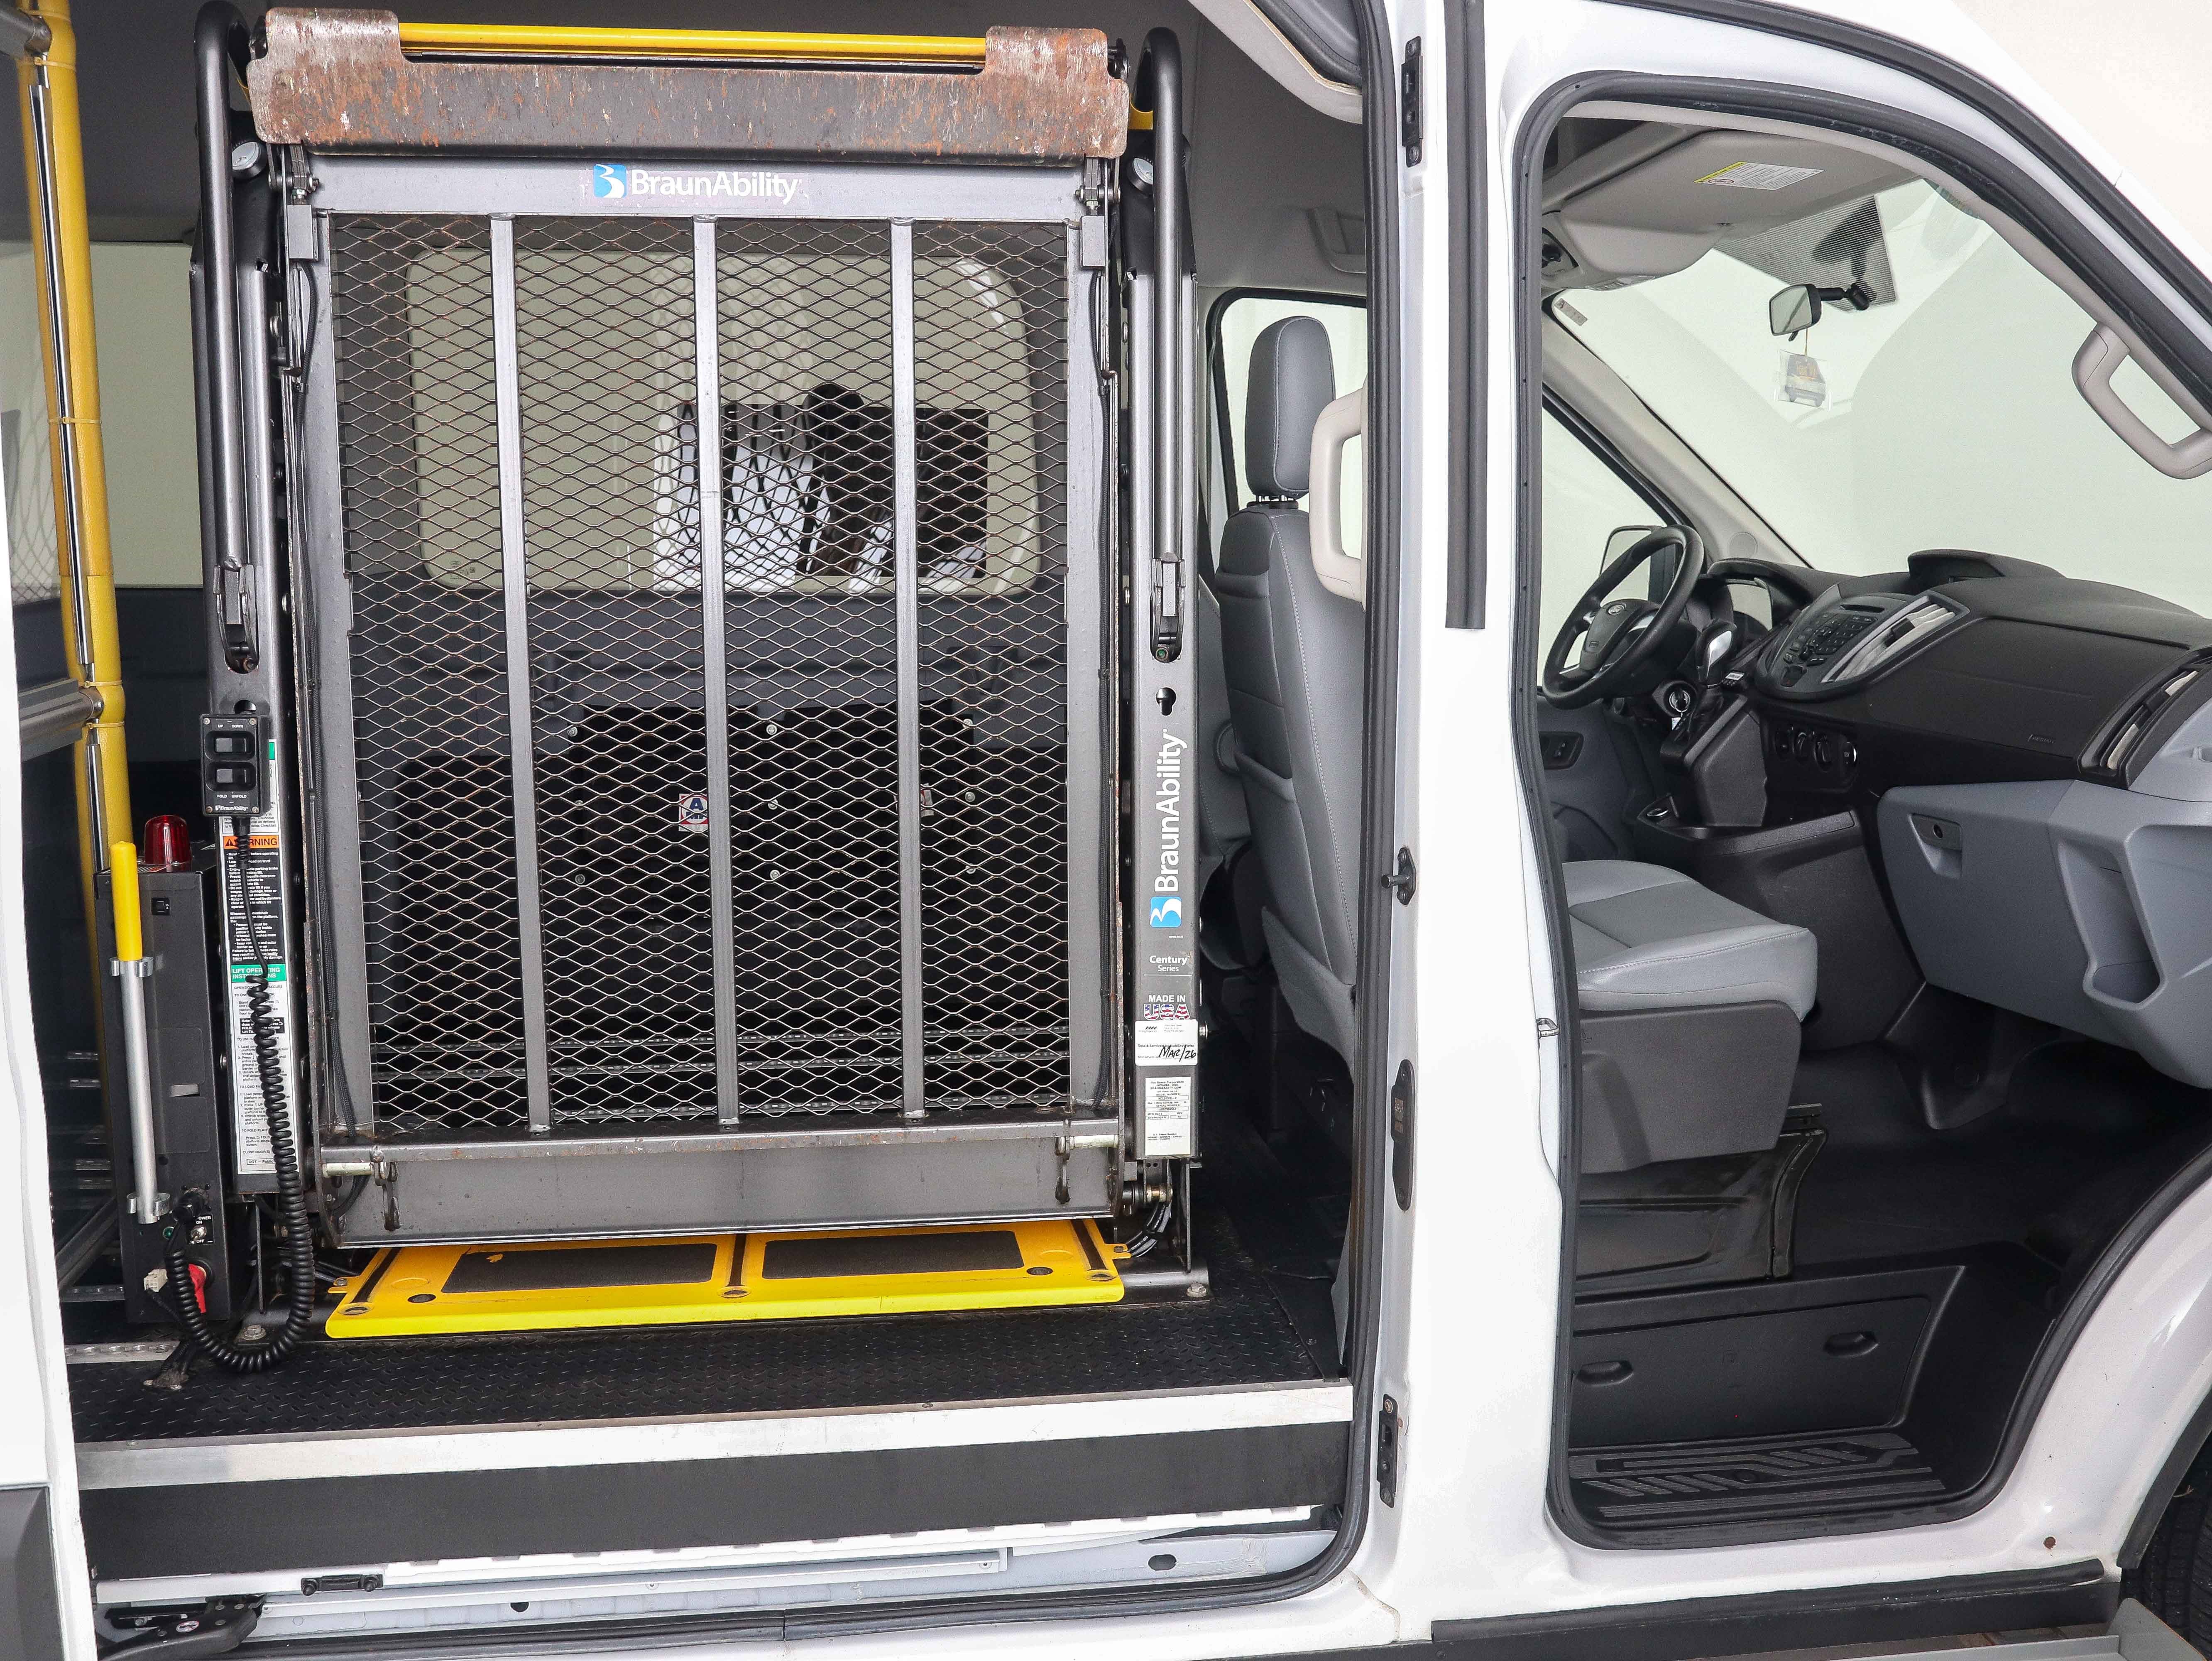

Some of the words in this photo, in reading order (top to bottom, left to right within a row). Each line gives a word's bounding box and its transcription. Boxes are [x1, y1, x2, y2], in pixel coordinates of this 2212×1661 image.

[631, 169, 799, 205] BraunAbility
[1154, 732, 1188, 892] BraunAbility
[1149, 955, 1188, 965] Century
[1144, 1003, 1190, 1021] USA
